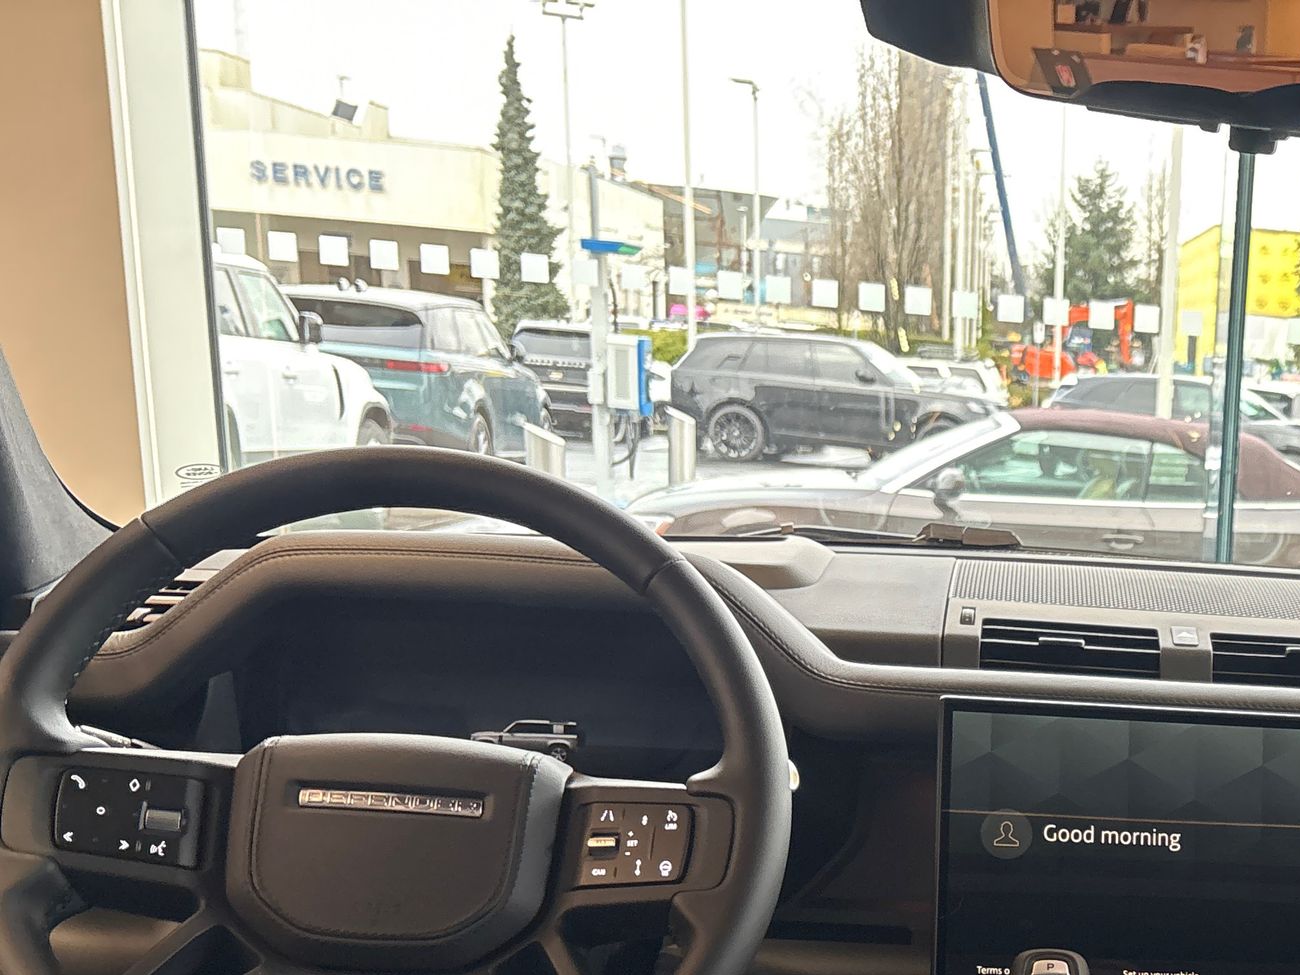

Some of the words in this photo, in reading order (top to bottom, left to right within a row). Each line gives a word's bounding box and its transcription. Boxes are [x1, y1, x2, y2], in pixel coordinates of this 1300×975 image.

[250, 160, 385, 193] SERVICE
[1043, 824, 1095, 843] Good
[1101, 828, 1181, 851] morning
[976, 966, 1002, 975] Terms
